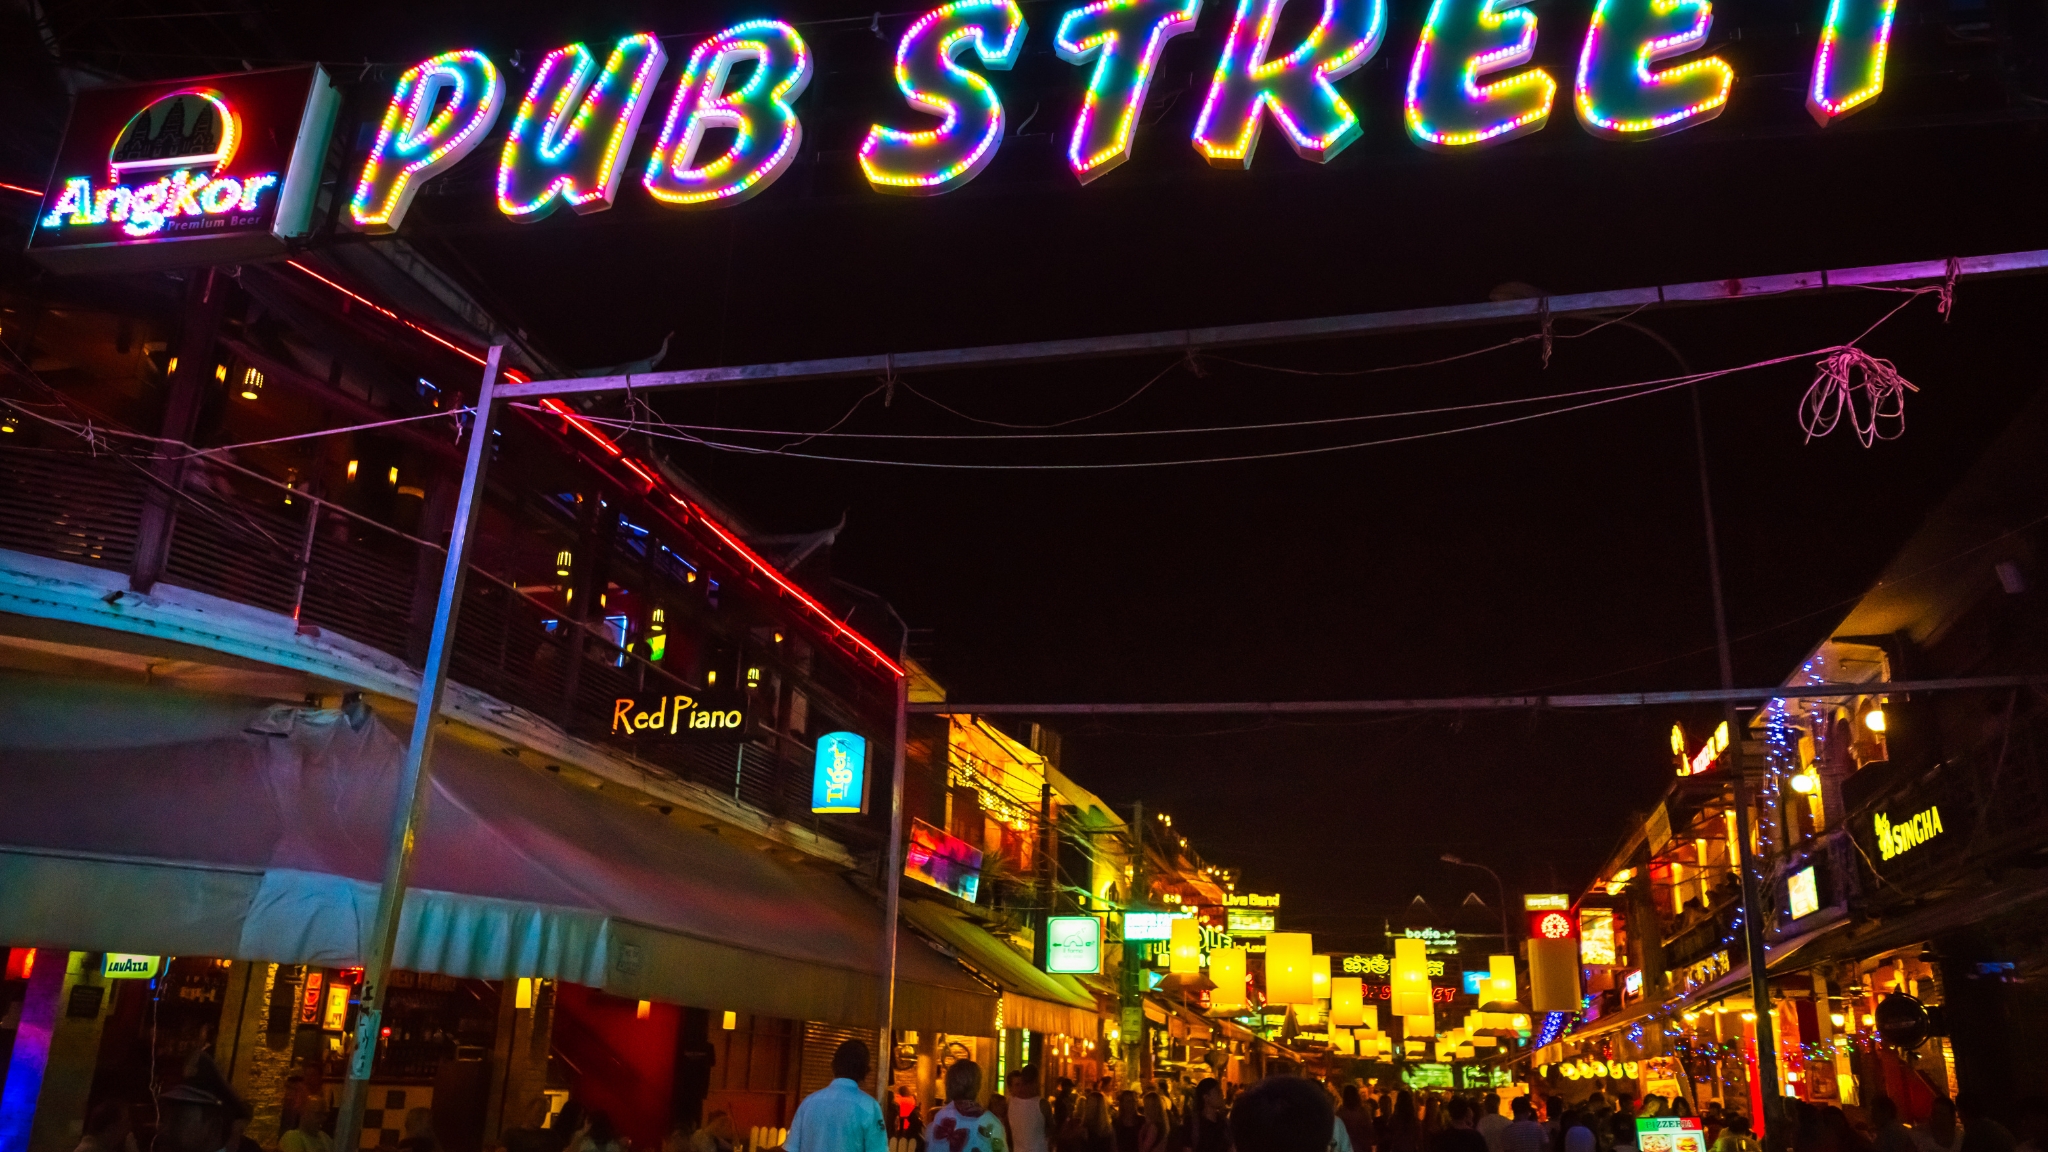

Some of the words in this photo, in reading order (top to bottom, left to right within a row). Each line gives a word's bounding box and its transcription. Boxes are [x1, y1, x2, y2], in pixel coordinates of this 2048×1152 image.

[349, 20, 813, 234] PUB
[42, 168, 278, 236] Angkor
[167, 217, 225, 231] Premium
[230, 214, 262, 227] Beer
[612, 696, 667, 734] Red
[671, 695, 742, 734] Piano
[826, 747, 853, 803] Tiger
[1892, 805, 1944, 855] SINGHA
[1249, 893, 1280, 906] Band
[108, 958, 149, 972] LAVAZZA
[1645, 1119, 1695, 1129] PIZZERIA
